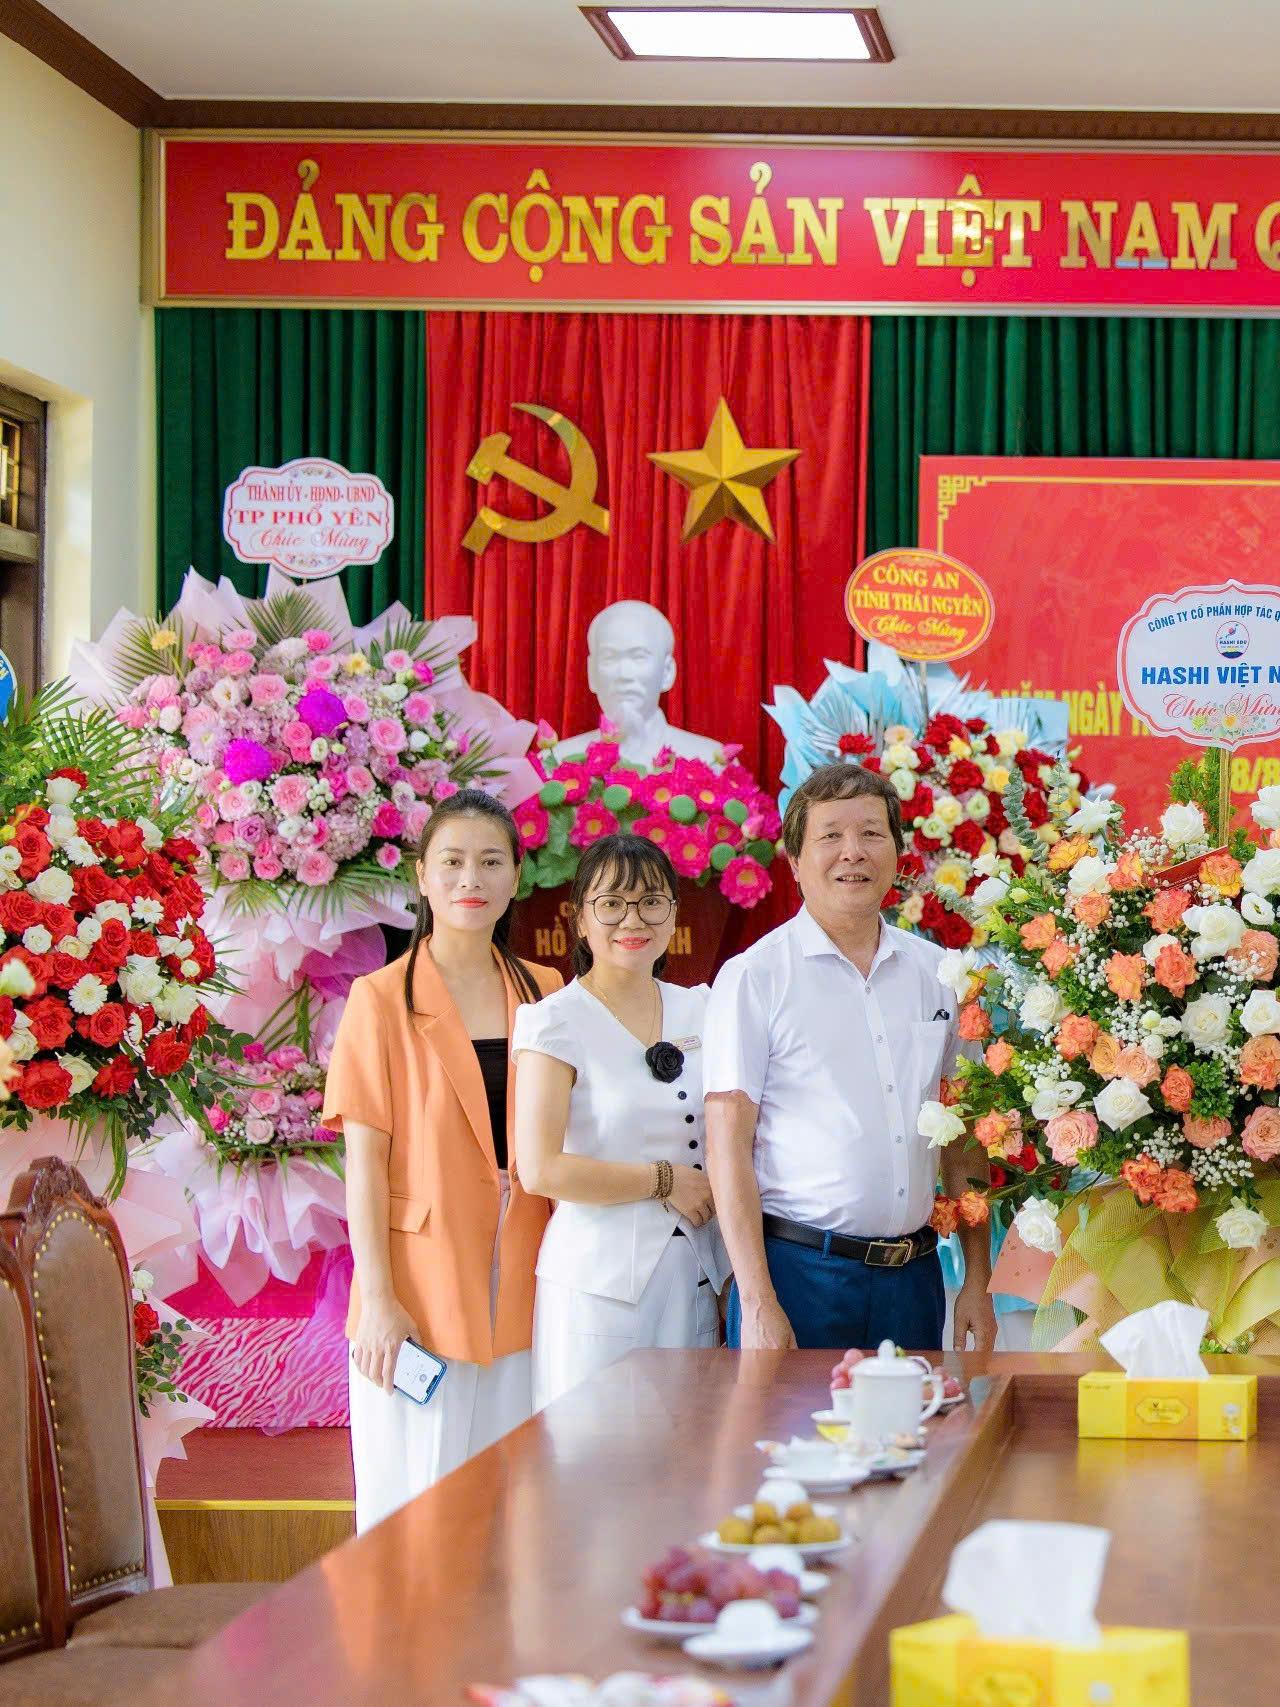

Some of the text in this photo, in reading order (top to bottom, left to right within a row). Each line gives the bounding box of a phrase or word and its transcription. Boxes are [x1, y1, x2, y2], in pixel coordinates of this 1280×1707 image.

[225, 158, 444, 262] ĐẢNG
[462, 168, 671, 283] CỘNG
[690, 161, 843, 266] SẢN
[863, 175, 1041, 287] VIỆT
[1060, 201, 1237, 270] NAM
[234, 510, 264, 524] TP
[331, 508, 383, 526] YÊN
[872, 562, 960, 589] CÔNG AN
[893, 589, 929, 611] THÁI
[1148, 617, 1175, 633] CÔNG
[1177, 612, 1188, 622] TY
[1234, 605, 1252, 619] HỢP
[1256, 604, 1272, 618] TÁC
[1141, 666, 1209, 684] HASHI
[1217, 662, 1262, 687] VIỆT
[1162, 693, 1218, 719] Chúc
